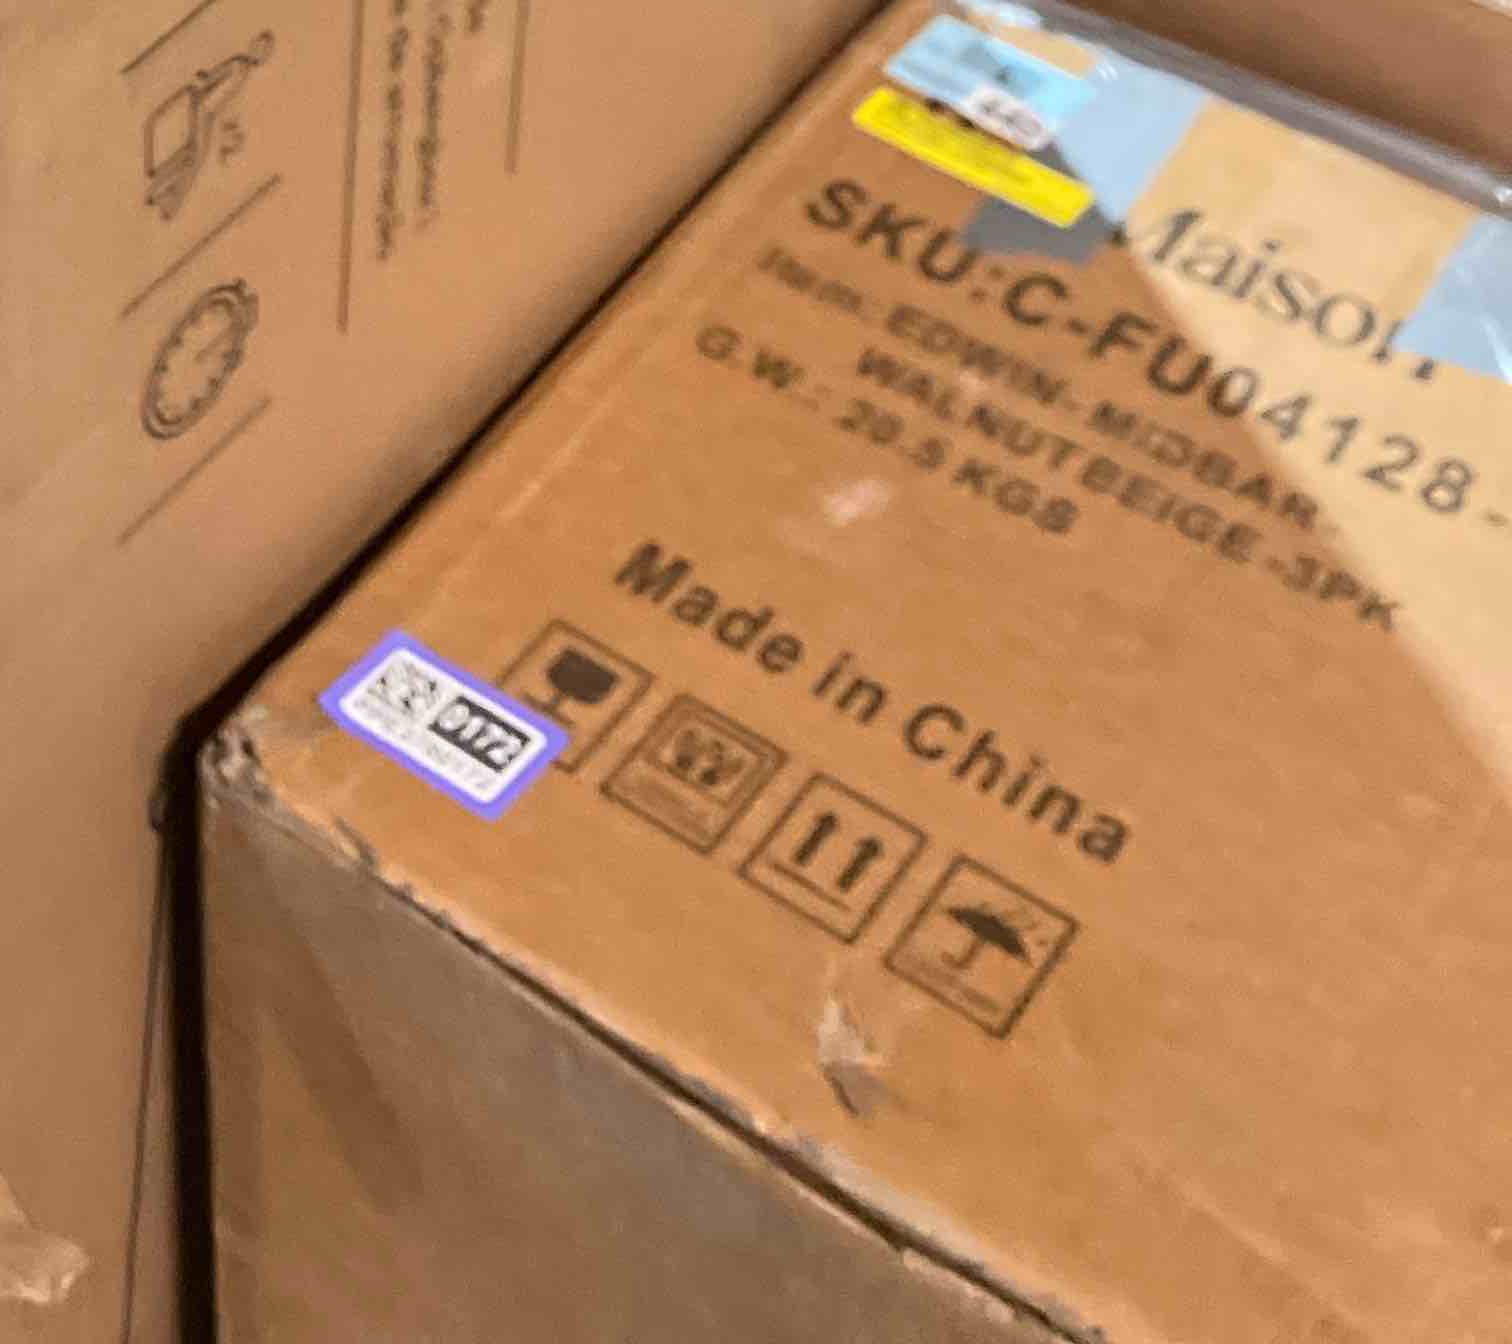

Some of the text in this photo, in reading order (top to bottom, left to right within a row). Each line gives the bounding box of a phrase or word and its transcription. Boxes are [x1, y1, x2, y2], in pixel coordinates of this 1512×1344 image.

[614, 540, 1134, 868] Made in China
